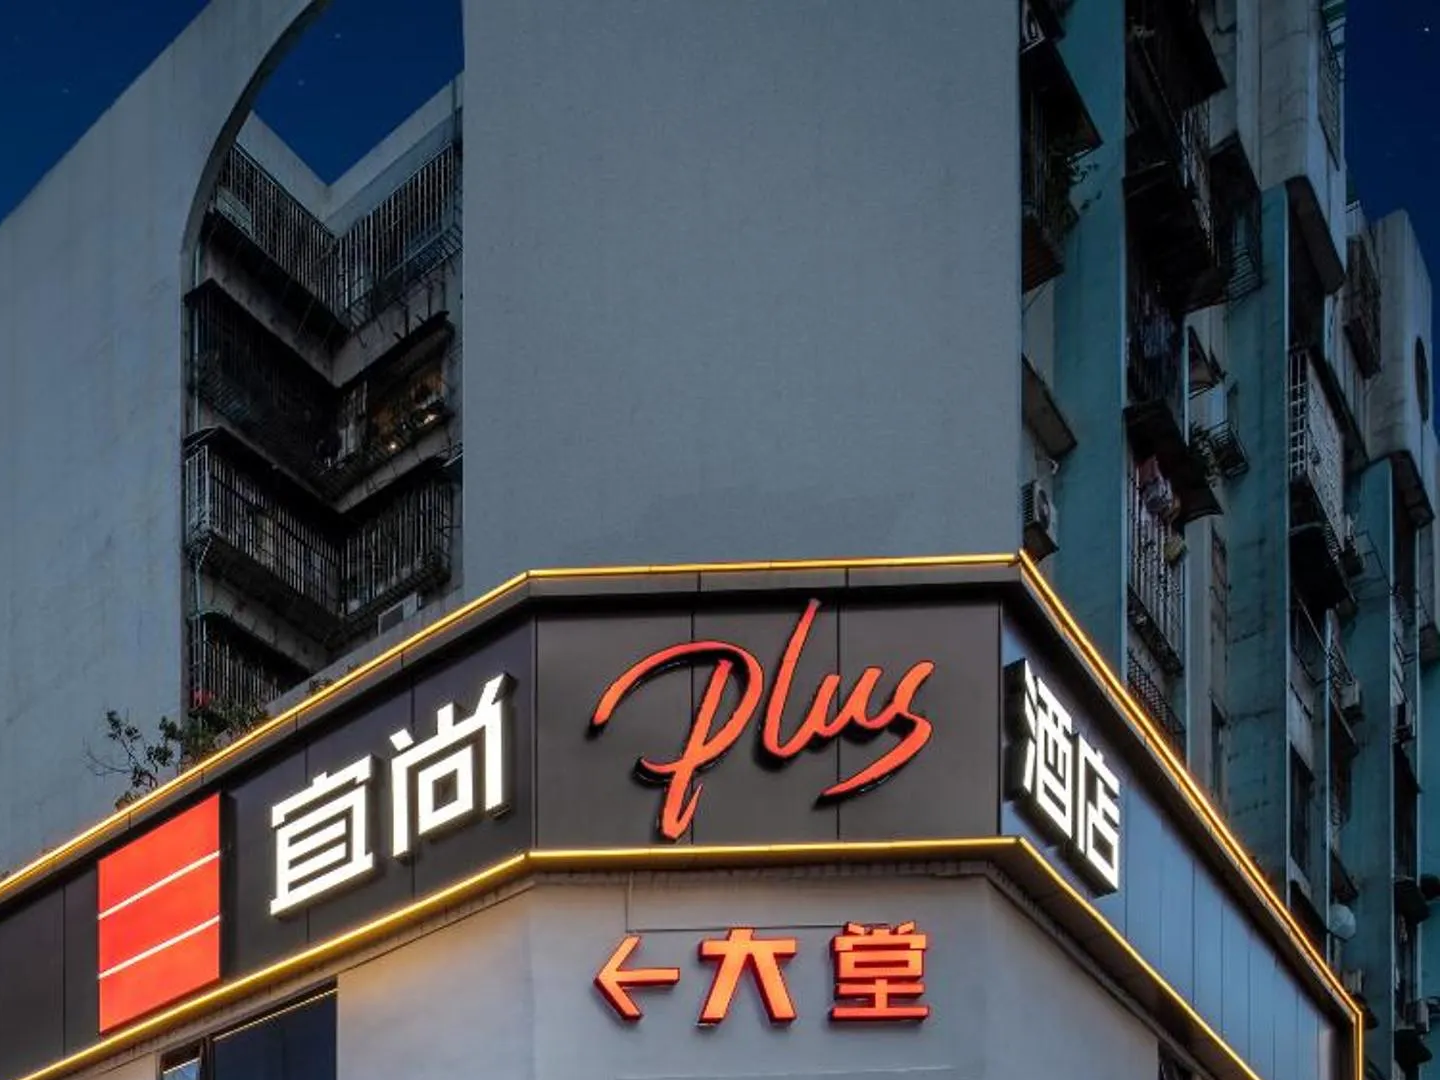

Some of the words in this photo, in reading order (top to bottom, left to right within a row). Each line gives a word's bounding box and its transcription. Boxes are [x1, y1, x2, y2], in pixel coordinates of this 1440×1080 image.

[270, 673, 512, 916] 宜尚
[591, 599, 935, 841] Plus
[1016, 659, 1121, 894] 酒店
[697, 920, 930, 1024] 大堂
